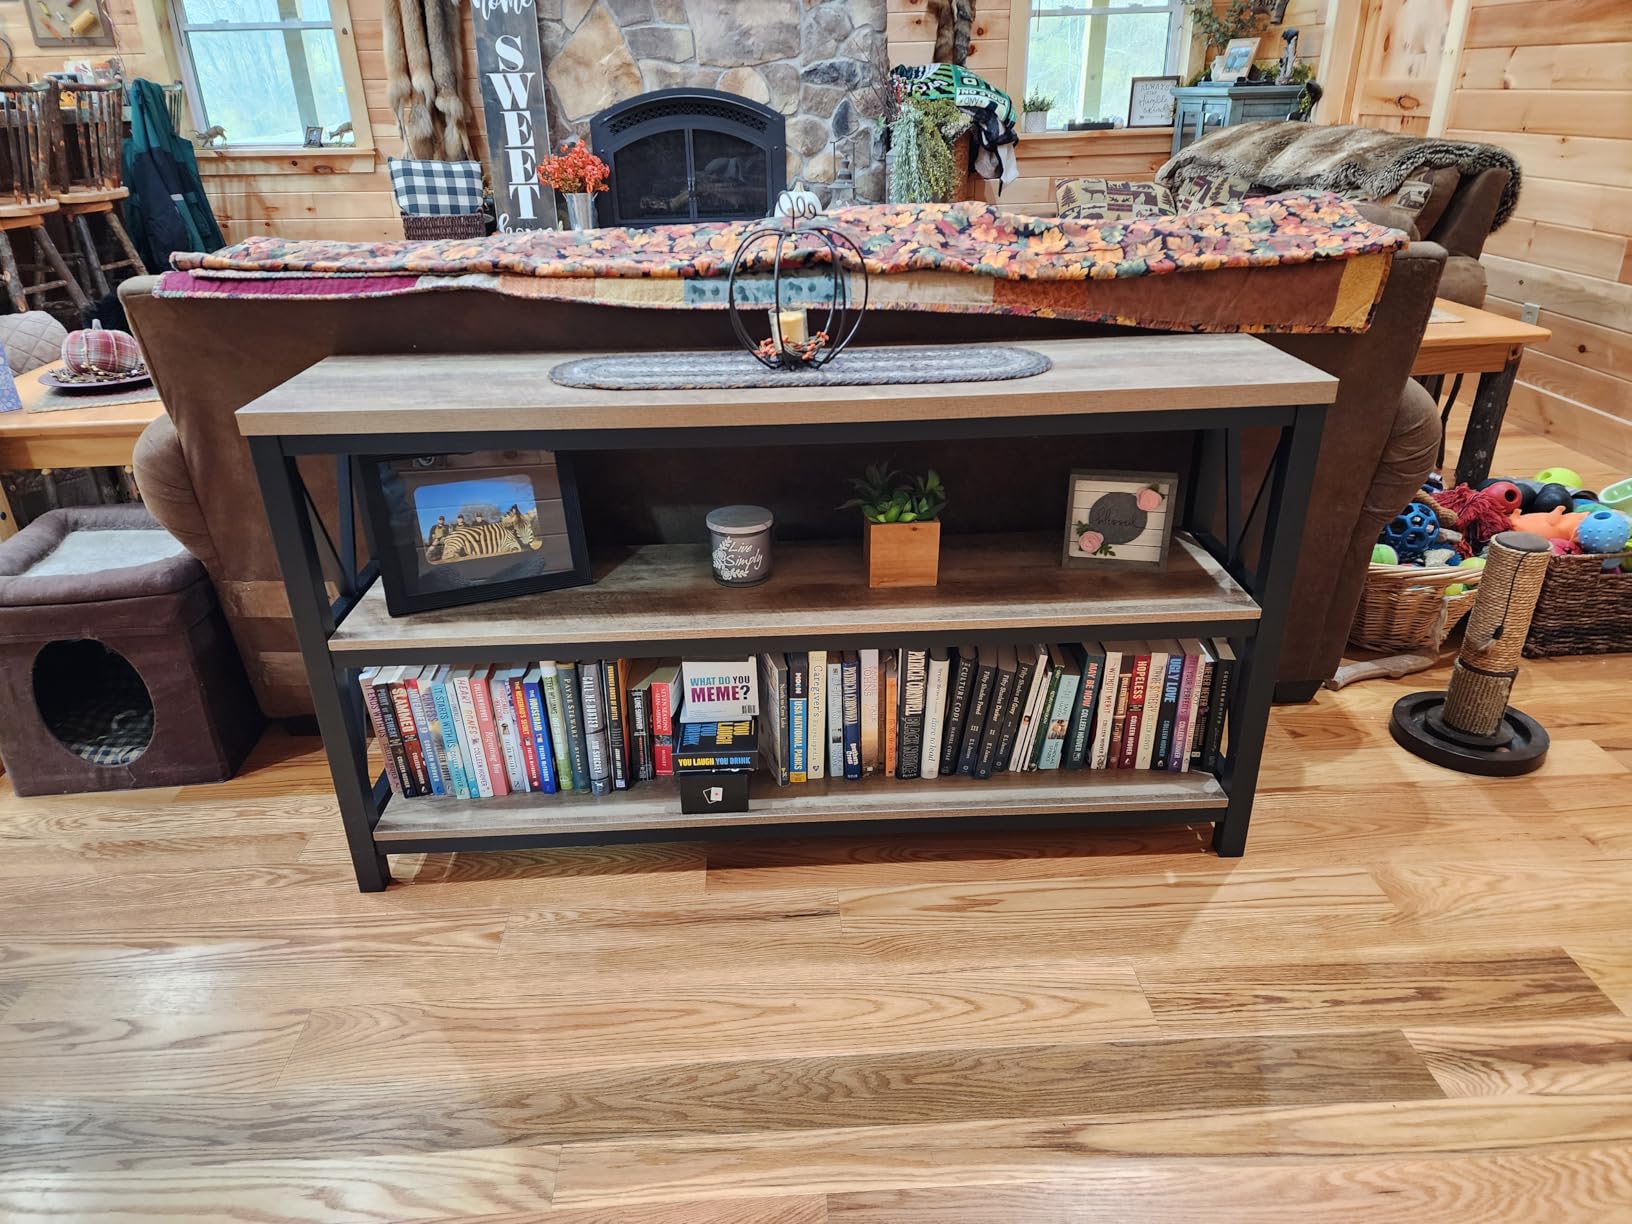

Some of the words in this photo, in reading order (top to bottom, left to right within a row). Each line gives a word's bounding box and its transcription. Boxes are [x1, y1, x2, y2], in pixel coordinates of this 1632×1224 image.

[486, 34, 540, 219] SWEET
[729, 542, 752, 553] Live
[725, 549, 763, 570] Simply
[907, 651, 925, 681] PATRICIA
[1017, 667, 1028, 679] Fifty
[1151, 665, 1164, 684] MAYBE
[1167, 658, 1182, 680] UGLY
[1204, 667, 1213, 685] NEVER
[545, 677, 554, 691] STEVE
[582, 676, 594, 691] CALL
[690, 677, 715, 686] WHAT
[718, 676, 730, 684] DO
[844, 667, 857, 694] PATRICIA
[956, 667, 968, 700] CULTURE
[981, 671, 990, 683] Fifty
[1000, 674, 1009, 686] Fifty
[1106, 667, 1116, 693] WITHOUT
[1120, 678, 1129, 696] COLLEEN
[1133, 661, 1147, 699] HOPELESS
[1186, 671, 1194, 685] YOUR
[1220, 671, 1229, 697] COLLEEN
[564, 678, 575, 703] PAYNE
[691, 685, 750, 703] MEME?
[811, 665, 823, 717] Caregiver's
[978, 683, 987, 700] Shades
[996, 687, 1006, 704] Shades
[1013, 679, 1024, 697] Shades
[1082, 690, 1093, 707] NOW
[1164, 682, 1179, 703] LOVE
[1200, 687, 1209, 706] NEVER
[408, 689, 424, 725] NOVEMBER
[422, 693, 438, 722] CONFESS
[436, 696, 448, 720] STARTS
[458, 680, 470, 704] HEART
[464, 710, 478, 734] BONES
[794, 701, 803, 715] USA
[905, 682, 924, 716] CORNWELL
[975, 701, 984, 715] Freed
[1009, 703, 1018, 715] Grey
[1103, 695, 1112, 713] MERIT
[1147, 686, 1161, 712] SOMEDAY
[1181, 688, 1192, 714] PERFECTS
[366, 693, 378, 710] ENDS
[372, 712, 383, 729] WITH
[378, 730, 386, 738] US
[391, 688, 414, 732] SLAMMED
[529, 698, 542, 731] HOUSEMAID
[586, 704, 598, 728] HUNTER
[635, 709, 643, 730] SURVIVOR
[844, 694, 857, 726] CORNWELL
[952, 702, 961, 722] CODE
[992, 705, 1002, 722] Darker
[1078, 709, 1089, 731] COLLEEN
[384, 714, 397, 737] RETREAT
[442, 722, 454, 738] WITH
[521, 719, 529, 735] SECRET
[568, 704, 578, 738] STEWART
[734, 722, 749, 736] YOU
[903, 717, 921, 744] BLACK
[930, 717, 939, 736] dare
[1128, 716, 1137, 736] COLLEEN
[1161, 720, 1170, 739] COLLEEN
[1177, 720, 1186, 740] COLLEEN
[683, 724, 700, 746] DRINK
[716, 722, 733, 744] LAUGH
[794, 716, 803, 748] NATIONAL
[948, 727, 956, 744] DANIEL
[1075, 731, 1084, 752] HOOVER
[424, 740, 434, 762] COLLEEN
[447, 740, 457, 748] US
[928, 745, 936, 762] lead
[999, 742, 1007, 754] James
[1126, 737, 1134, 755] HOOVER
[1159, 740, 1167, 757] HOOVER
[1174, 741, 1183, 758] HOOVER
[473, 748, 482, 767] COLLEEN
[478, 767, 487, 787] HOOVER
[574, 747, 582, 773] STEWART
[592, 751, 602, 773] SHOCKEY
[678, 758, 692, 767] YOU
[693, 757, 714, 766] LAUGH
[715, 757, 729, 765] YOU
[730, 756, 750, 765] DRINK
[794, 749, 803, 770] PARKS
[902, 746, 918, 774] NOTICE
